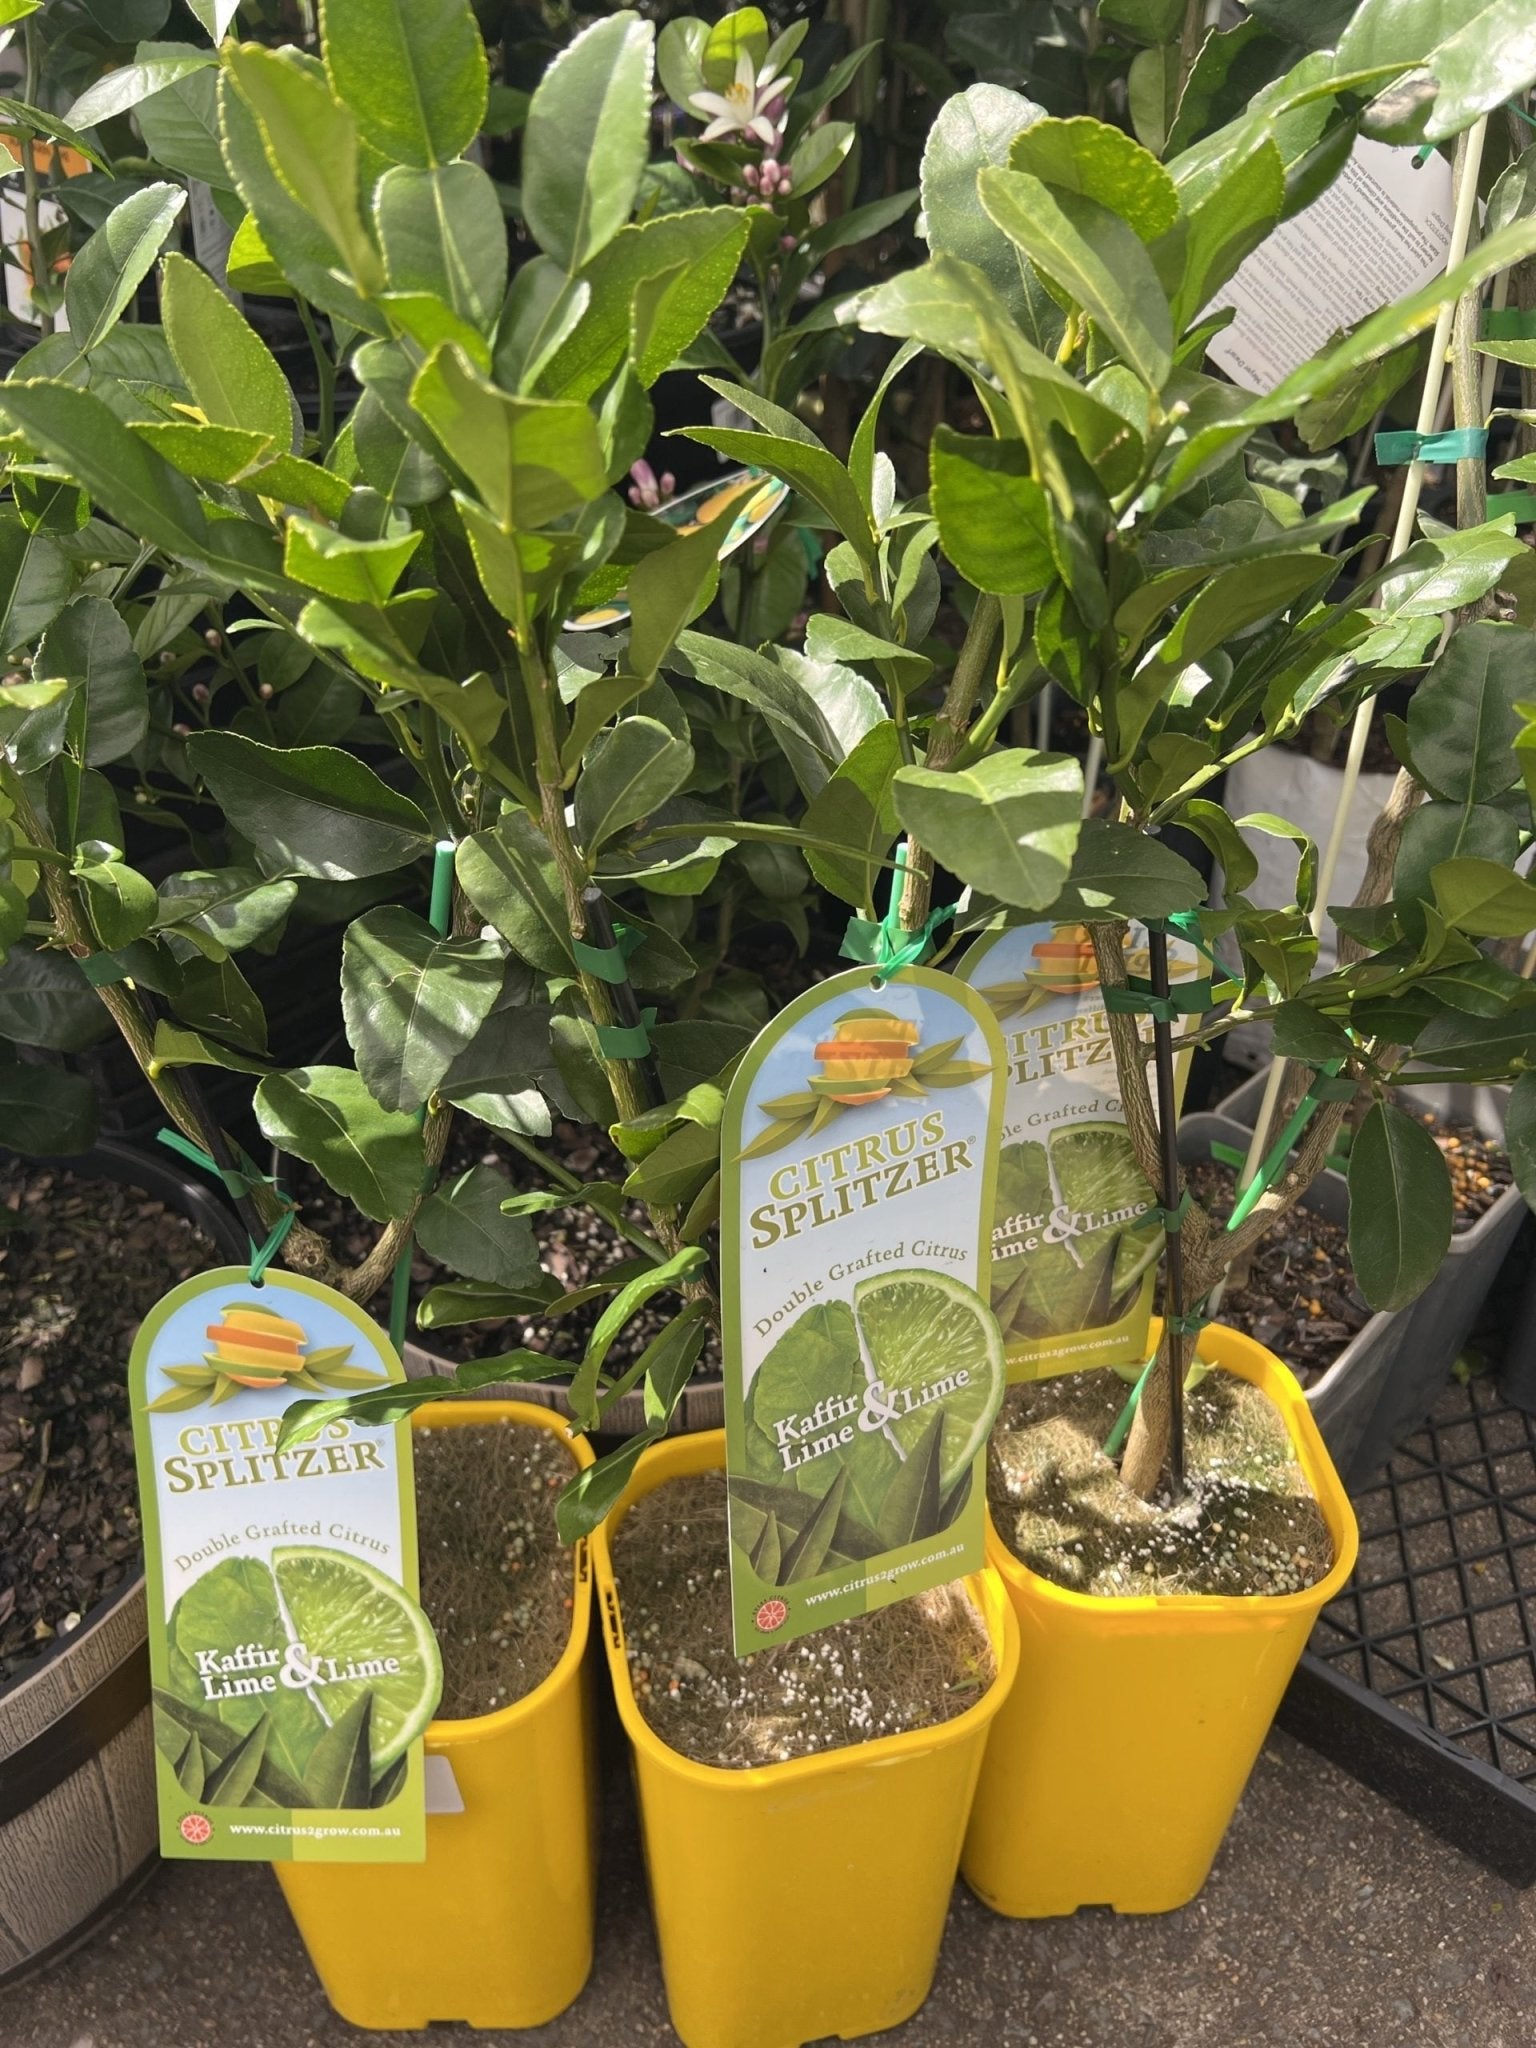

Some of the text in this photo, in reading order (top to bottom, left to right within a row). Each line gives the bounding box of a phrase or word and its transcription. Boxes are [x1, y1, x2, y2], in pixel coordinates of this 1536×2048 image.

[1028, 1100, 1099, 1127] Grafted
[769, 1110, 945, 1202] CITRUS
[992, 1202, 1148, 1244] affir & Lime
[992, 1237, 1039, 1262] ime
[753, 1240, 969, 1338] Double Grafted Citrus
[773, 1394, 858, 1448] Kaffir
[857, 1368, 971, 1433] & Lime
[178, 1418, 349, 1456] CITRS
[779, 1425, 855, 1473] Lime
[174, 1520, 391, 1572] Double Grafted Citrus
[803, 1542, 966, 1608] www.citrus2grow.com.au
[195, 1642, 400, 1689] Kaffir & Lime
[201, 1672, 278, 1701] Lime
[229, 1823, 401, 1841] www.citrus2grow.com.au
